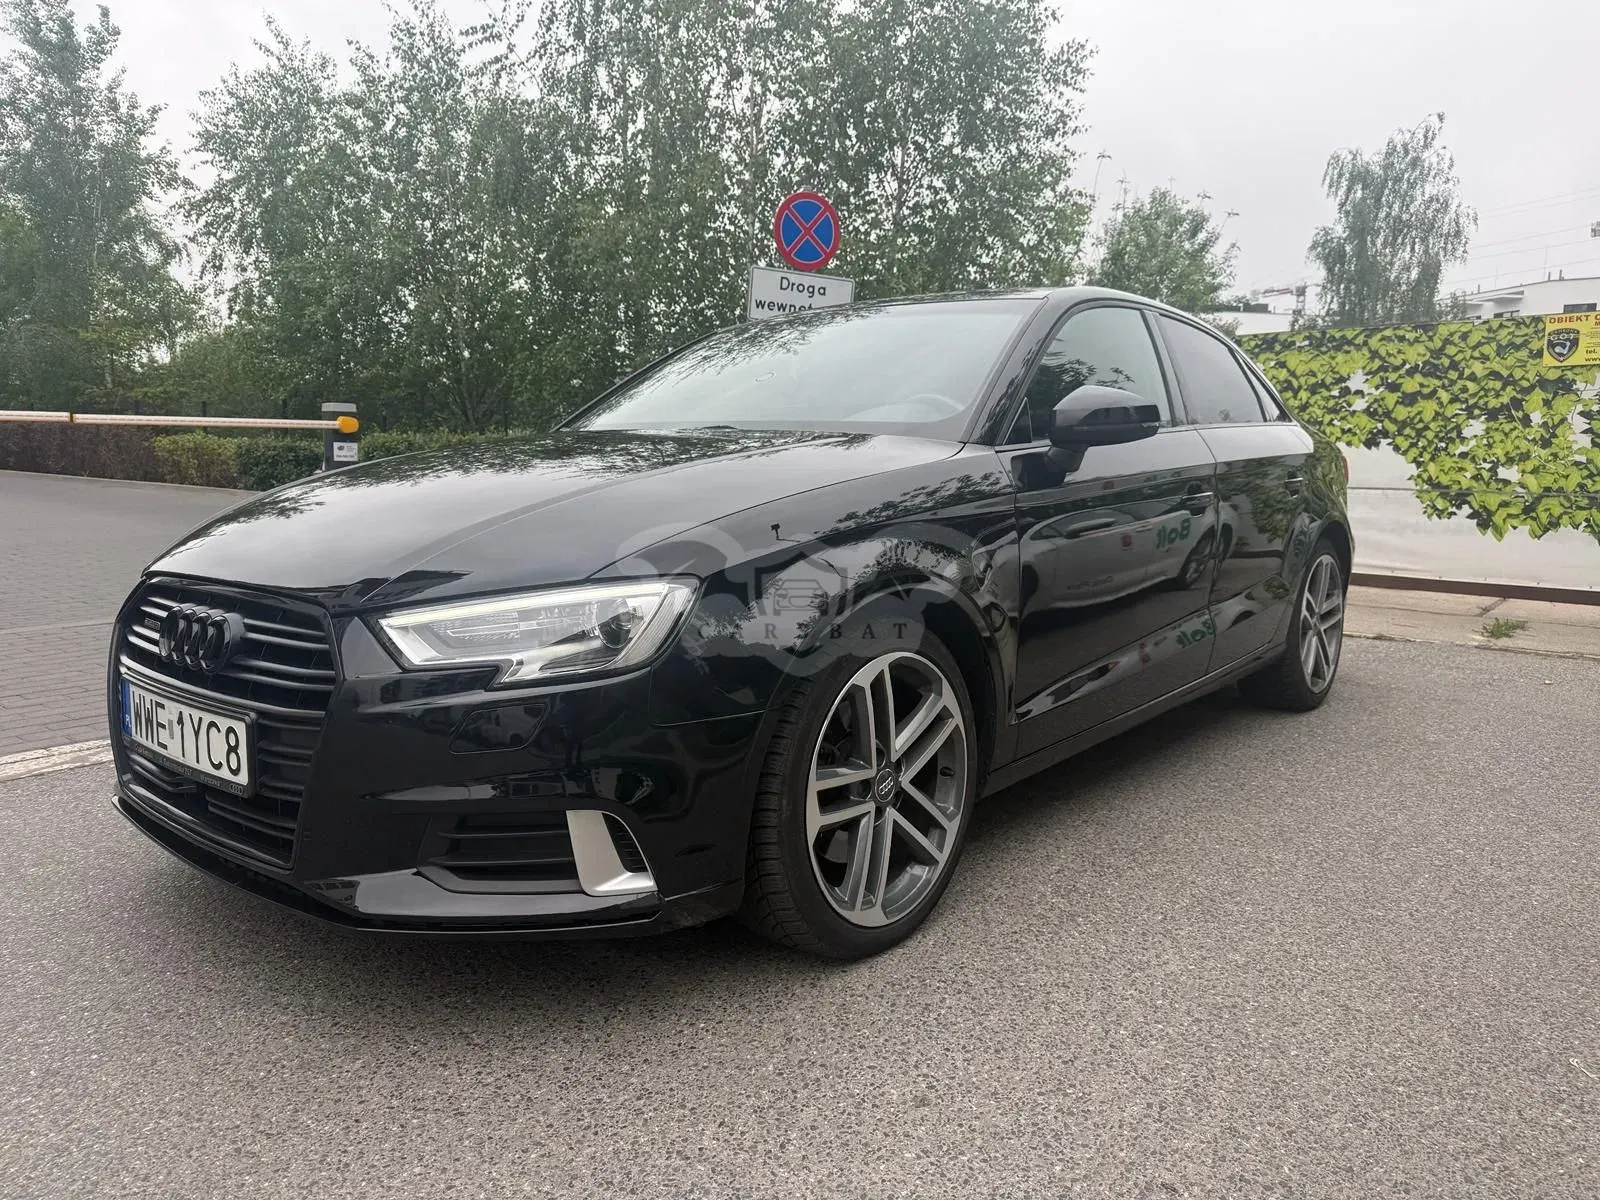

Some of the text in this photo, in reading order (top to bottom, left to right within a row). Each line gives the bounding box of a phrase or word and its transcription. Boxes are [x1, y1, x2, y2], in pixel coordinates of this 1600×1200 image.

[780, 276, 826, 298] Droga
[1549, 315, 1591, 324] OBIEKT
[132, 689, 241, 776] WWE 1YC8
